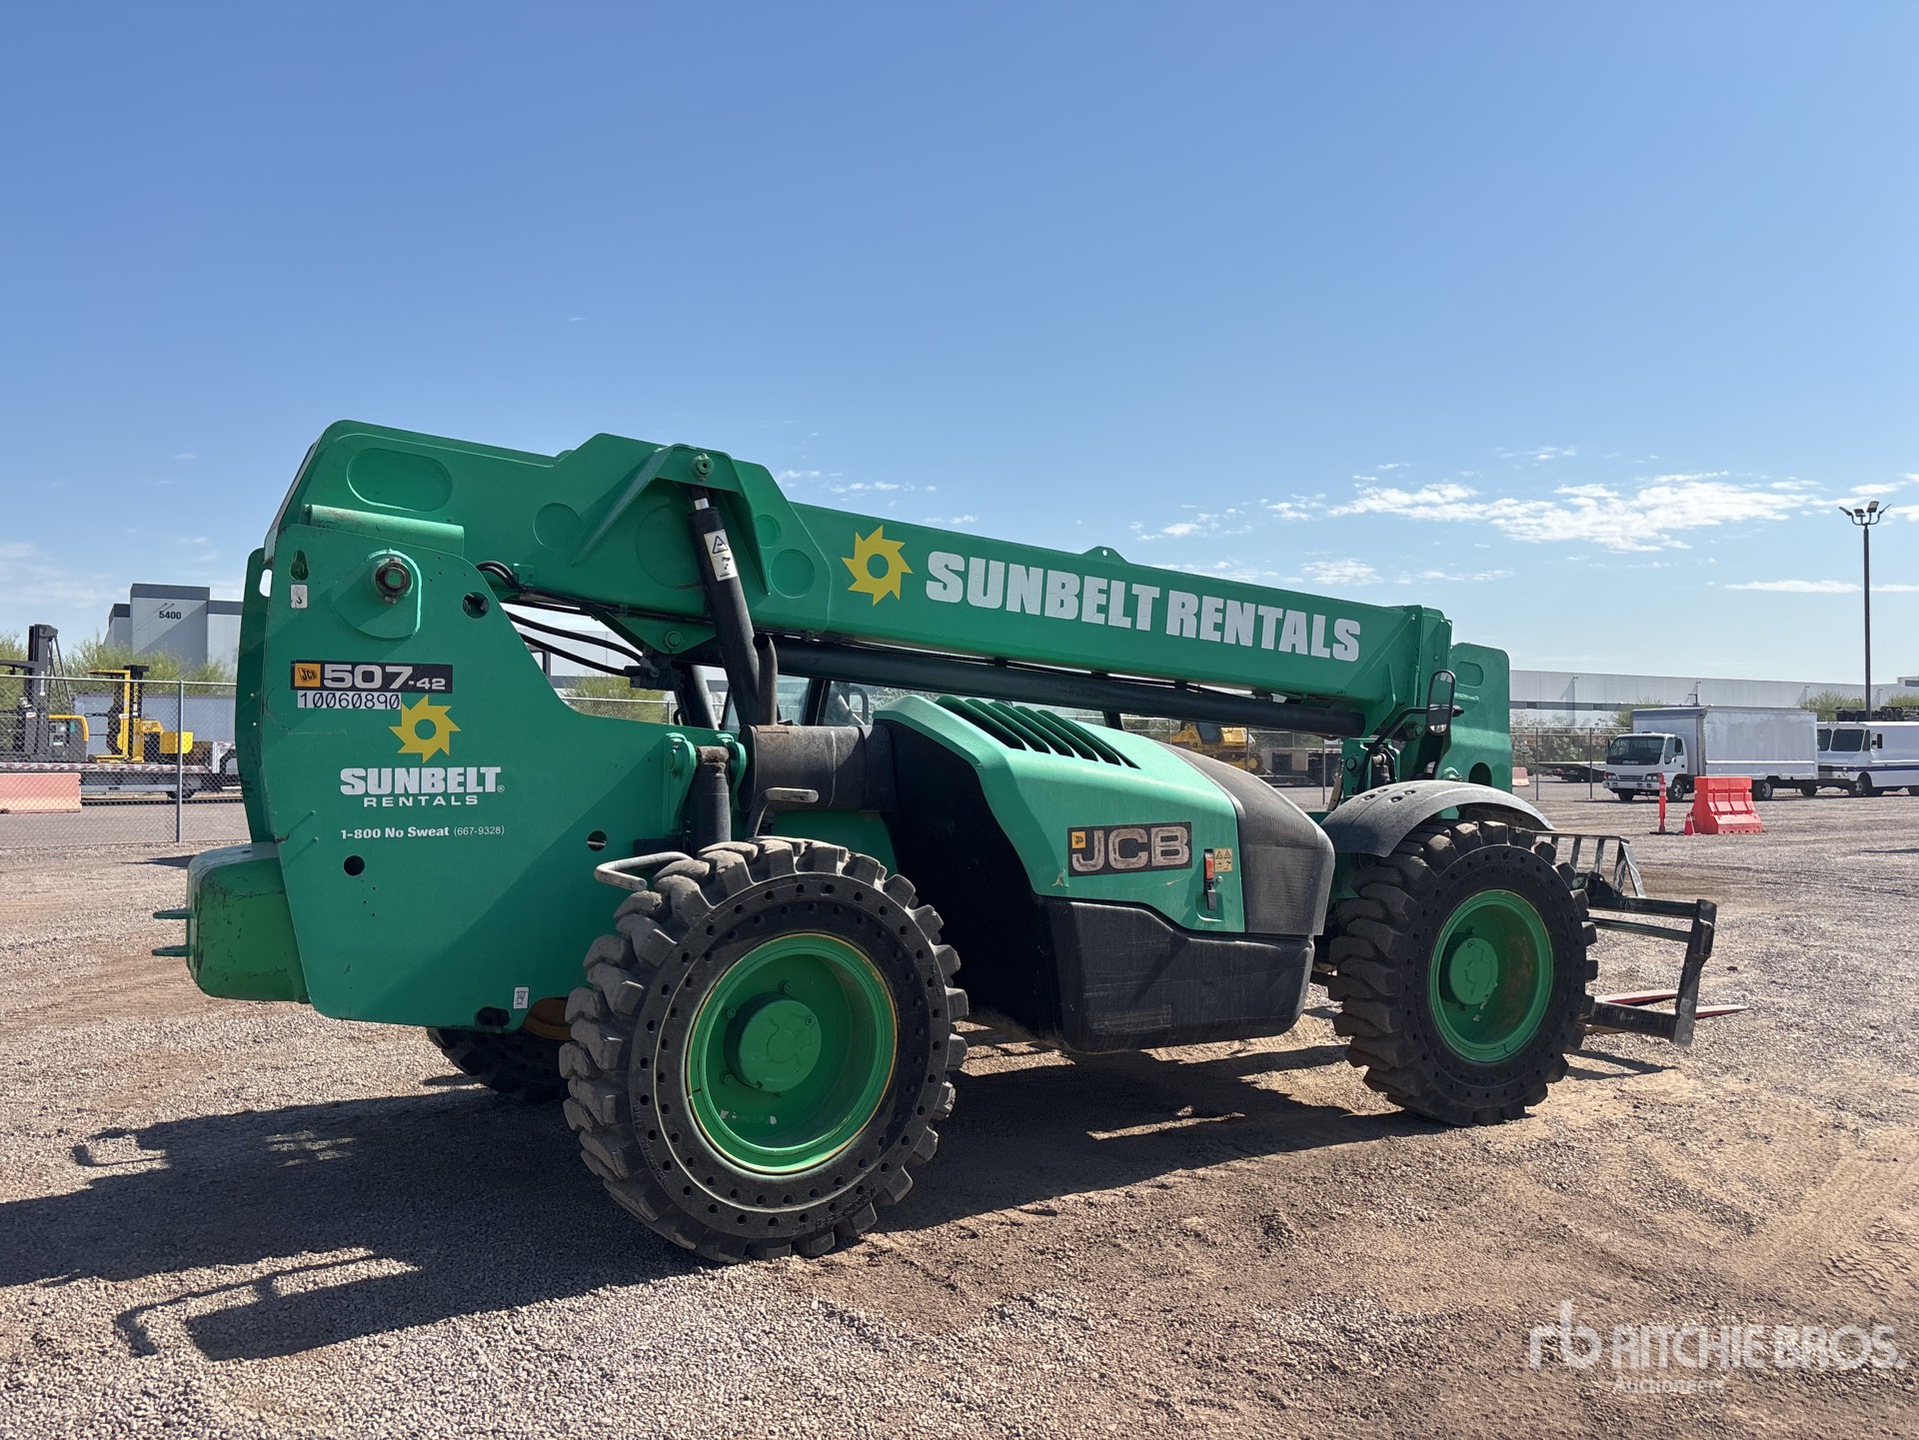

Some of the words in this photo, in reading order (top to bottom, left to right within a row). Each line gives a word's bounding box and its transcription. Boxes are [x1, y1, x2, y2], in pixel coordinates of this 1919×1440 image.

[926, 551, 1160, 631] SUNBELT
[1165, 589, 1361, 662] RENTALS
[159, 610, 182, 620] 5400
[300, 692, 400, 709] 10060890
[363, 795, 479, 808] RENTALS
[340, 828, 381, 839] 1-800
[385, 827, 404, 838] No
[407, 826, 449, 838] Sweat
[454, 825, 505, 837] (667-9328)
[1072, 826, 1190, 872] JCB
